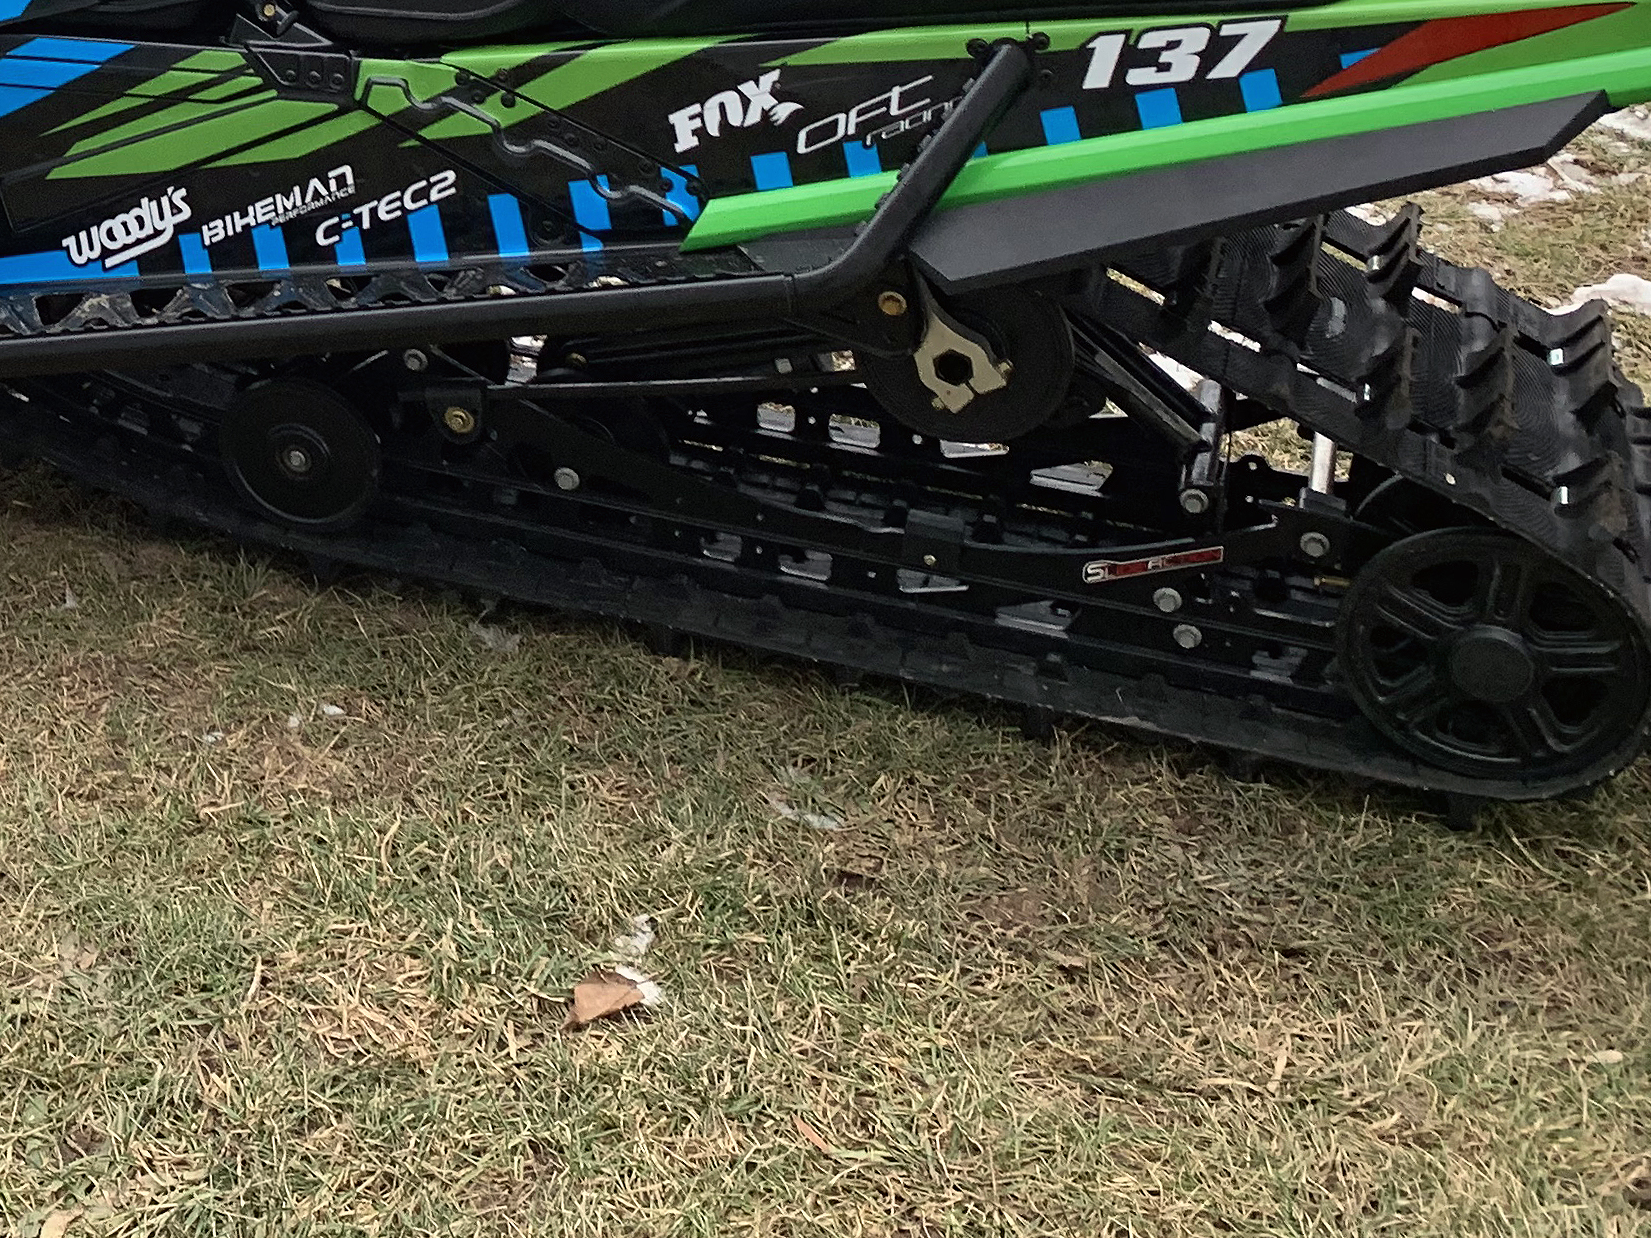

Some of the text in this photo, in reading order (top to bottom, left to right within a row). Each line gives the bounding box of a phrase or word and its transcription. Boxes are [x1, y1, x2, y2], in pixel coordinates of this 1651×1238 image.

[1081, 18, 1283, 90] 137
[668, 68, 796, 154] FOX
[271, 184, 356, 227] PERFORMANCE
